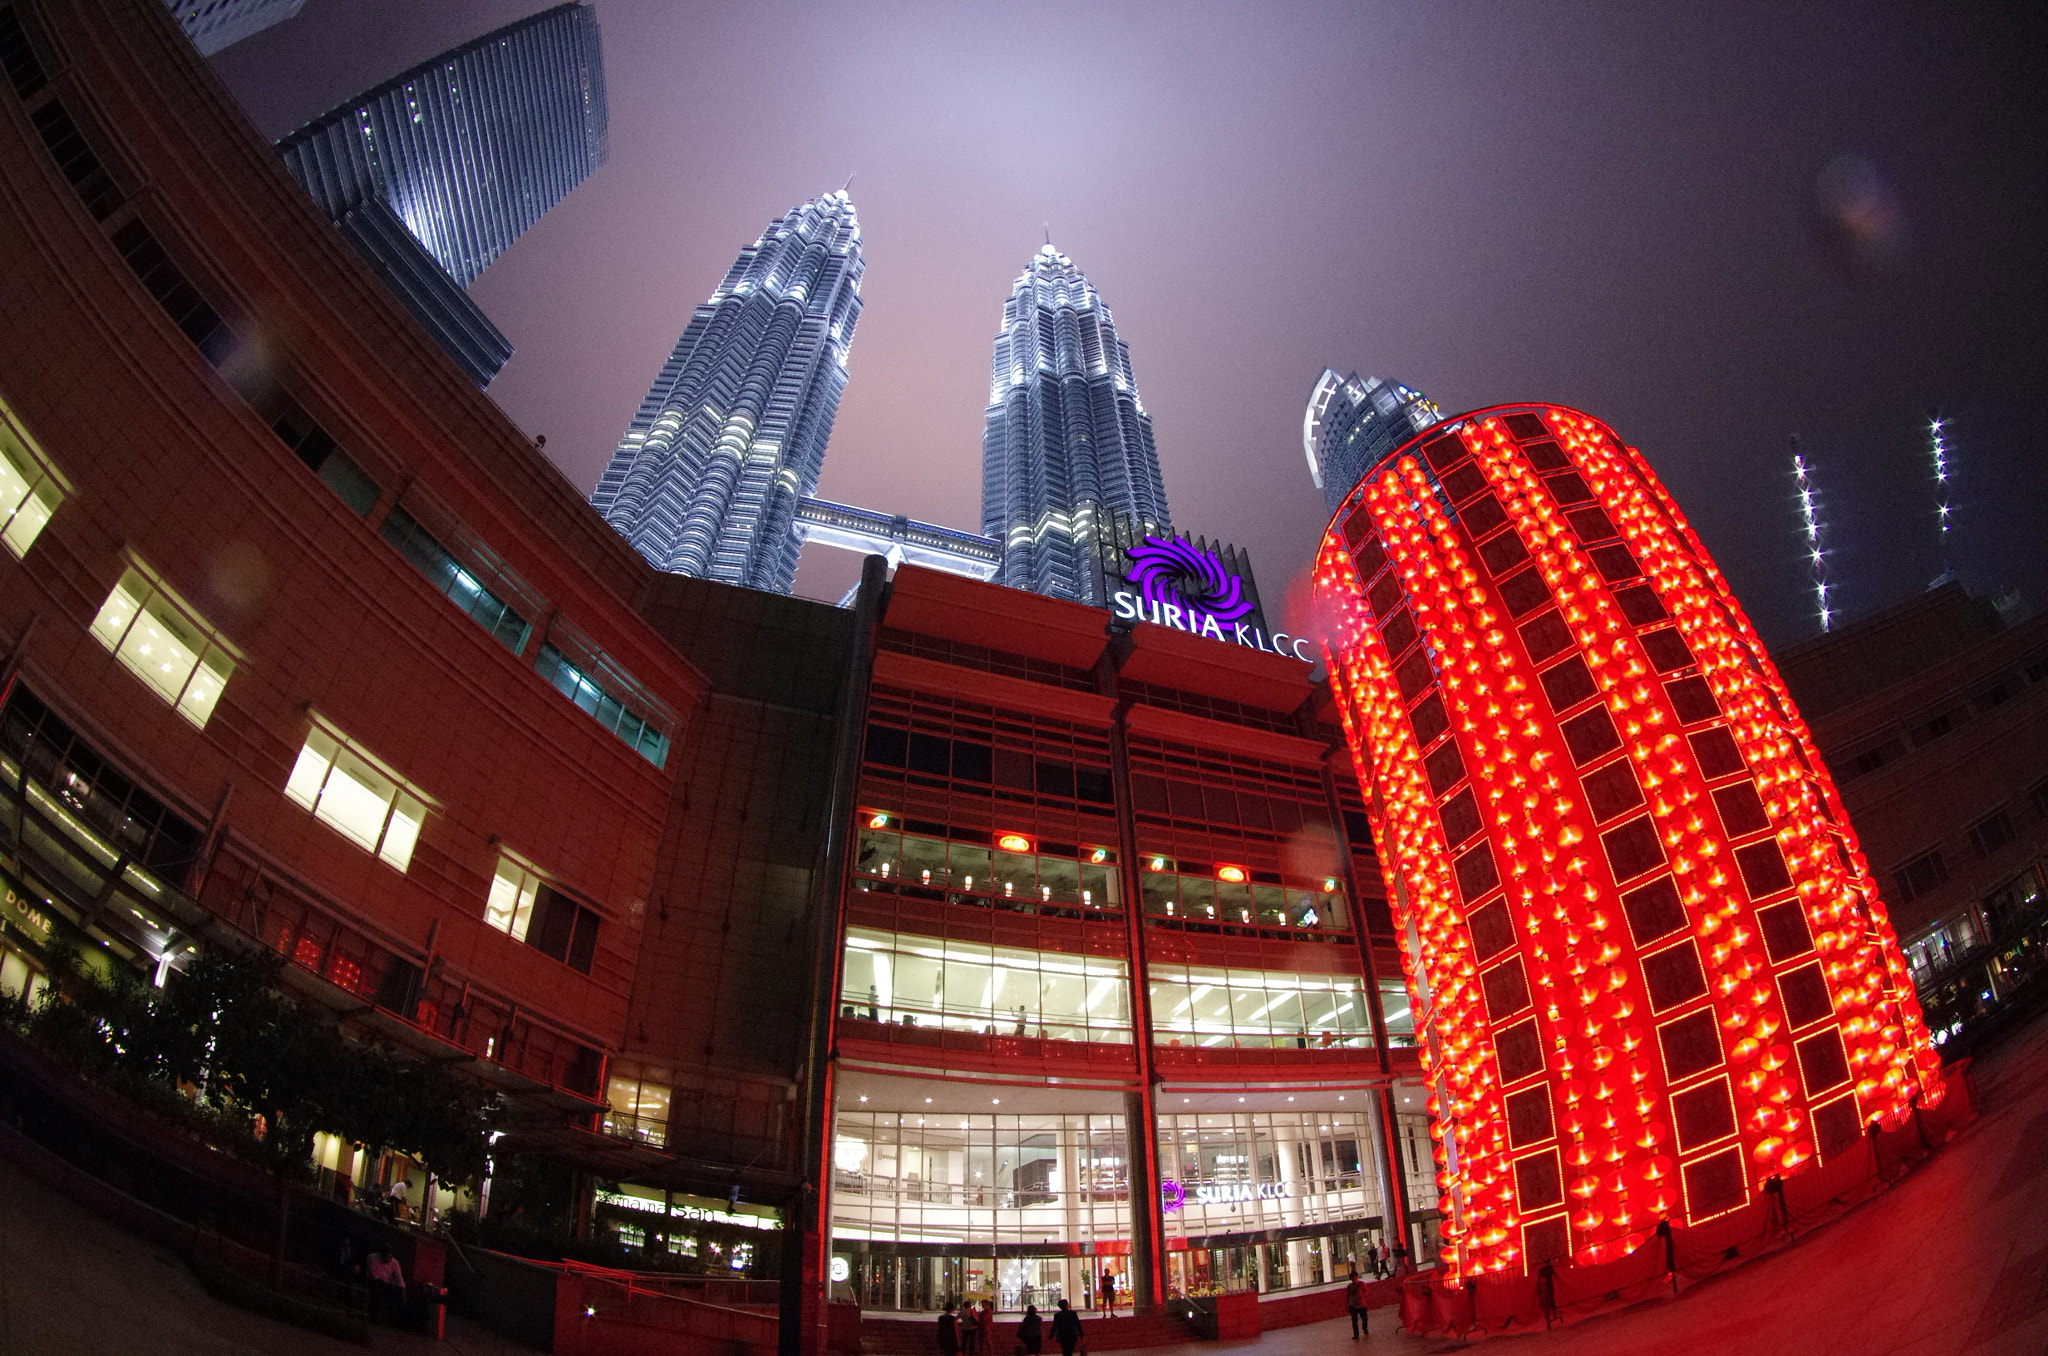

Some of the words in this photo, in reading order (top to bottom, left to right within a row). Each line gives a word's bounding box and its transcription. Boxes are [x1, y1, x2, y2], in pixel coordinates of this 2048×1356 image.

[1114, 591, 1225, 642] SURIA
[1234, 622, 1313, 663] KLCC
[5, 889, 51, 934] DOME
[1196, 1184, 1254, 1205] SURIA
[1256, 1181, 1294, 1199] KLCC
